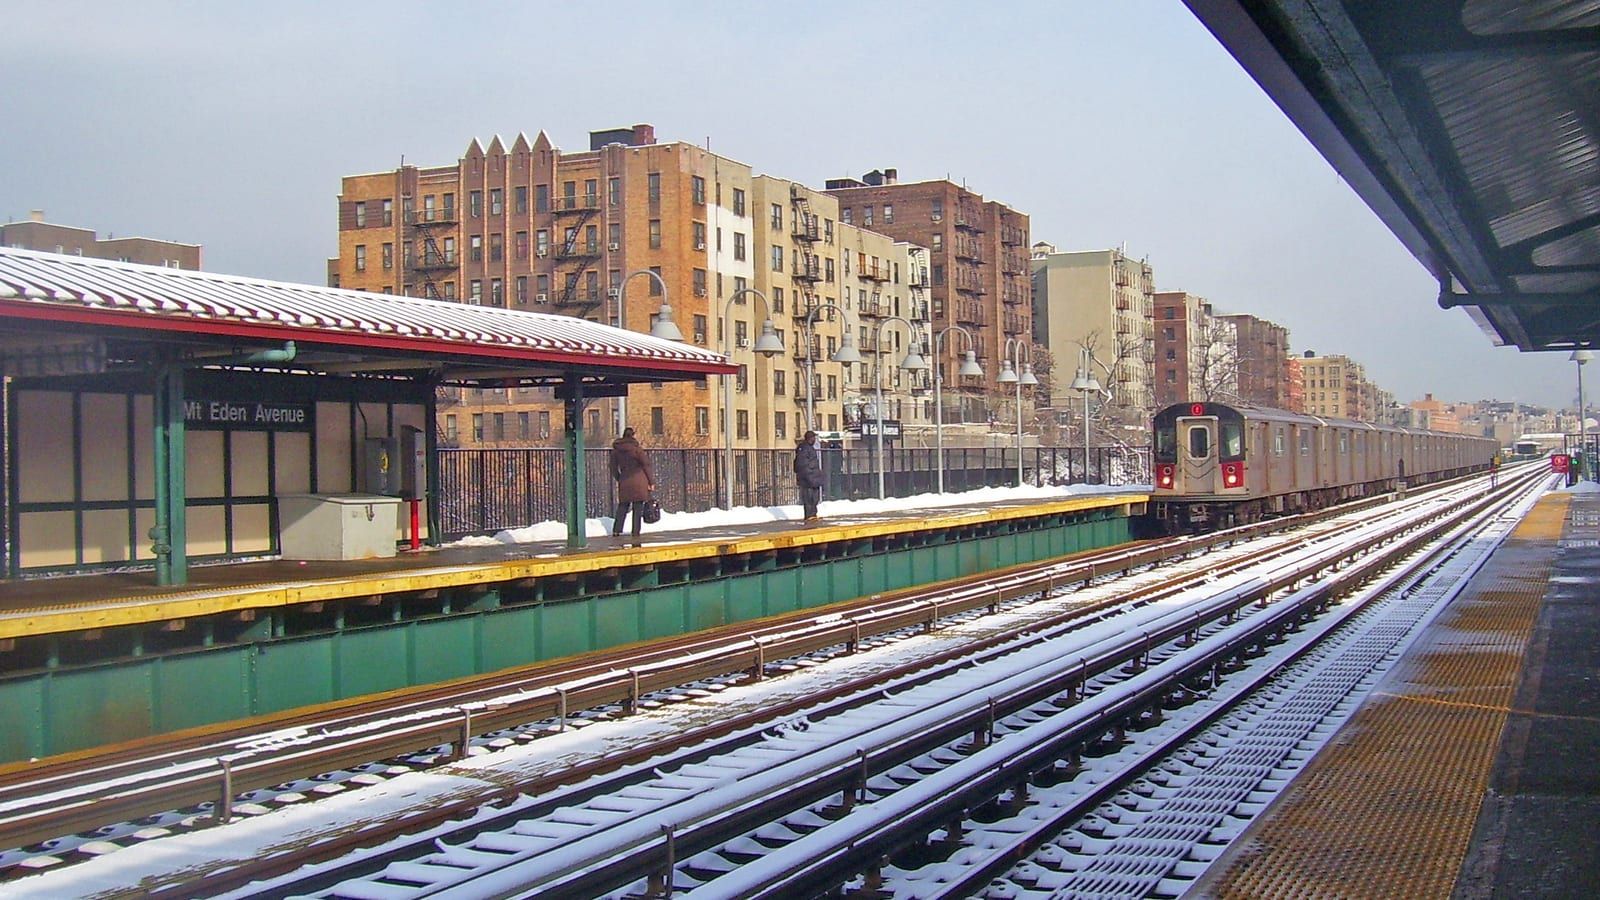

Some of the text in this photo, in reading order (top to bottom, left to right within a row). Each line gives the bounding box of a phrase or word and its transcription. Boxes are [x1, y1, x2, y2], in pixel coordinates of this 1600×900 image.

[184, 401, 305, 423] Mt Eden Avenue
